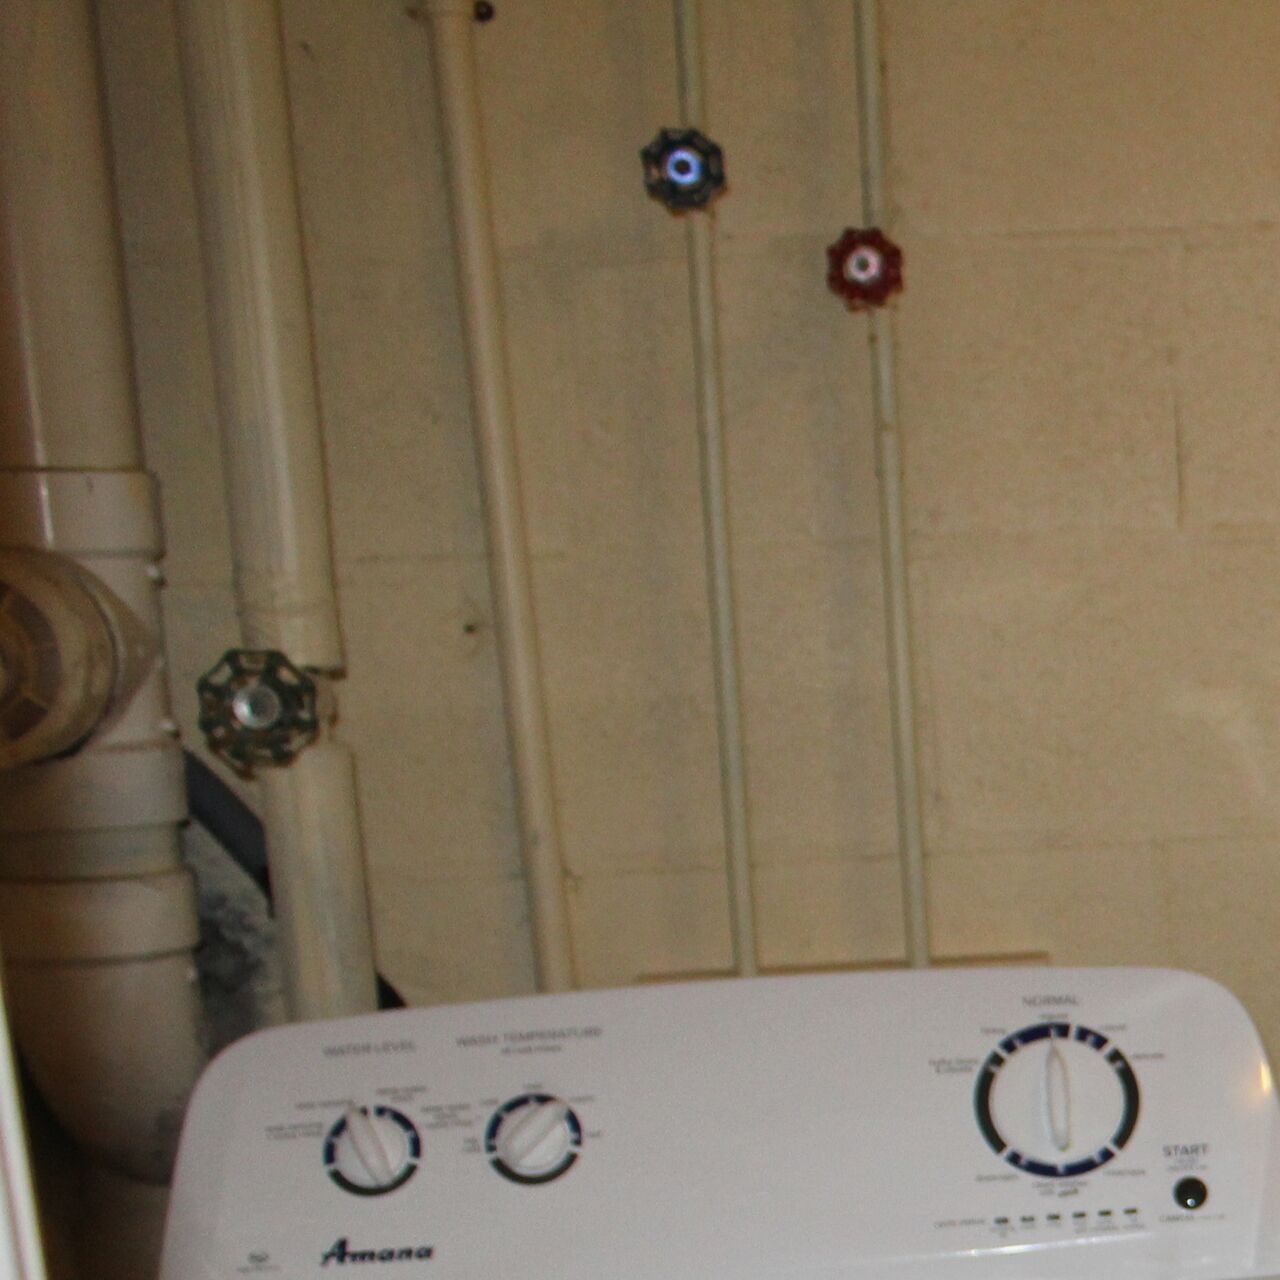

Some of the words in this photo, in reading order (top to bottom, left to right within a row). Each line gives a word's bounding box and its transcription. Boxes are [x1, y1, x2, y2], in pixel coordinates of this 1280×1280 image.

[1022, 995, 1079, 1007] NORMAL
[1162, 1143, 1208, 1158] START
[320, 1237, 434, 1267] Amana
